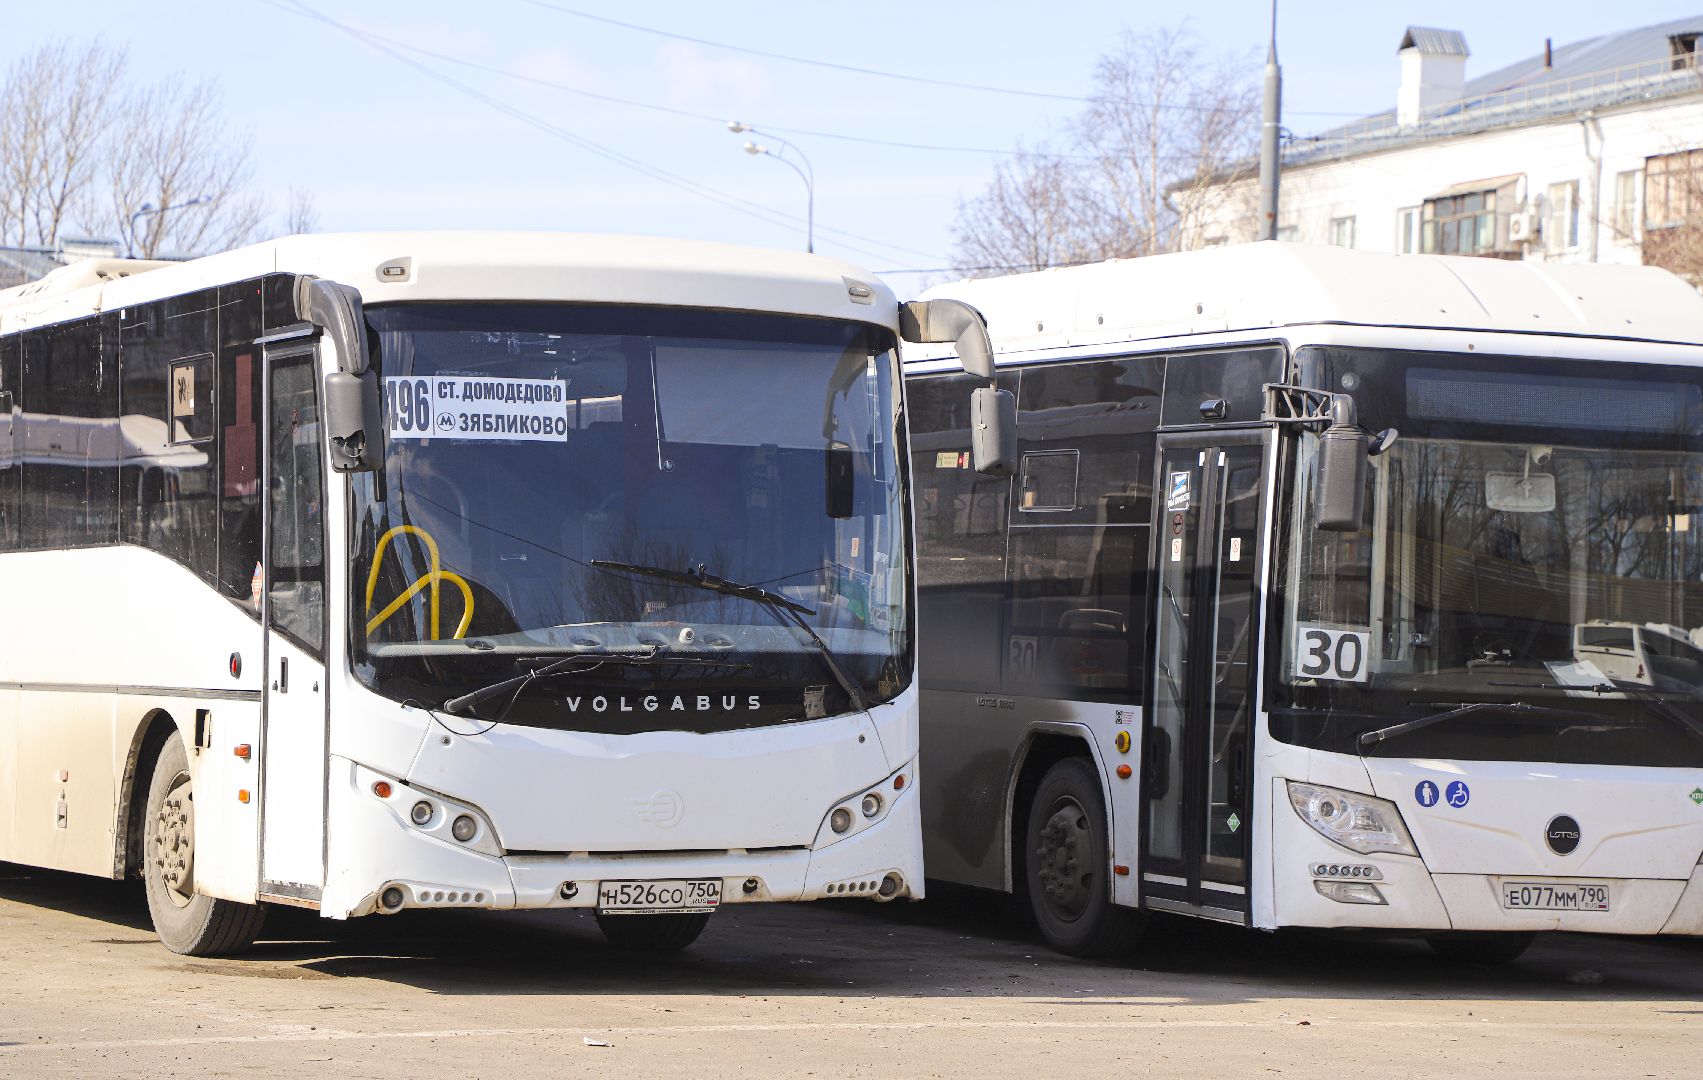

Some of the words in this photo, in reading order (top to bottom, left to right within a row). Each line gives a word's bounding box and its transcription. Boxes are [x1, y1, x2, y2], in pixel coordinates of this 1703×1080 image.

[437, 381, 460, 399] СТ.
[462, 382, 562, 404] ДОМОДЕДОВО
[459, 413, 567, 436] ЗЯБЛИКОВО
[1302, 630, 1362, 679] 30
[566, 695, 761, 713] VOLGABUS
[1549, 831, 1579, 839] LOTOS
[606, 884, 683, 905] Н526СО
[687, 882, 716, 898] 750
[1509, 887, 1577, 907] Е077ММ
[1579, 887, 1604, 903] 790
